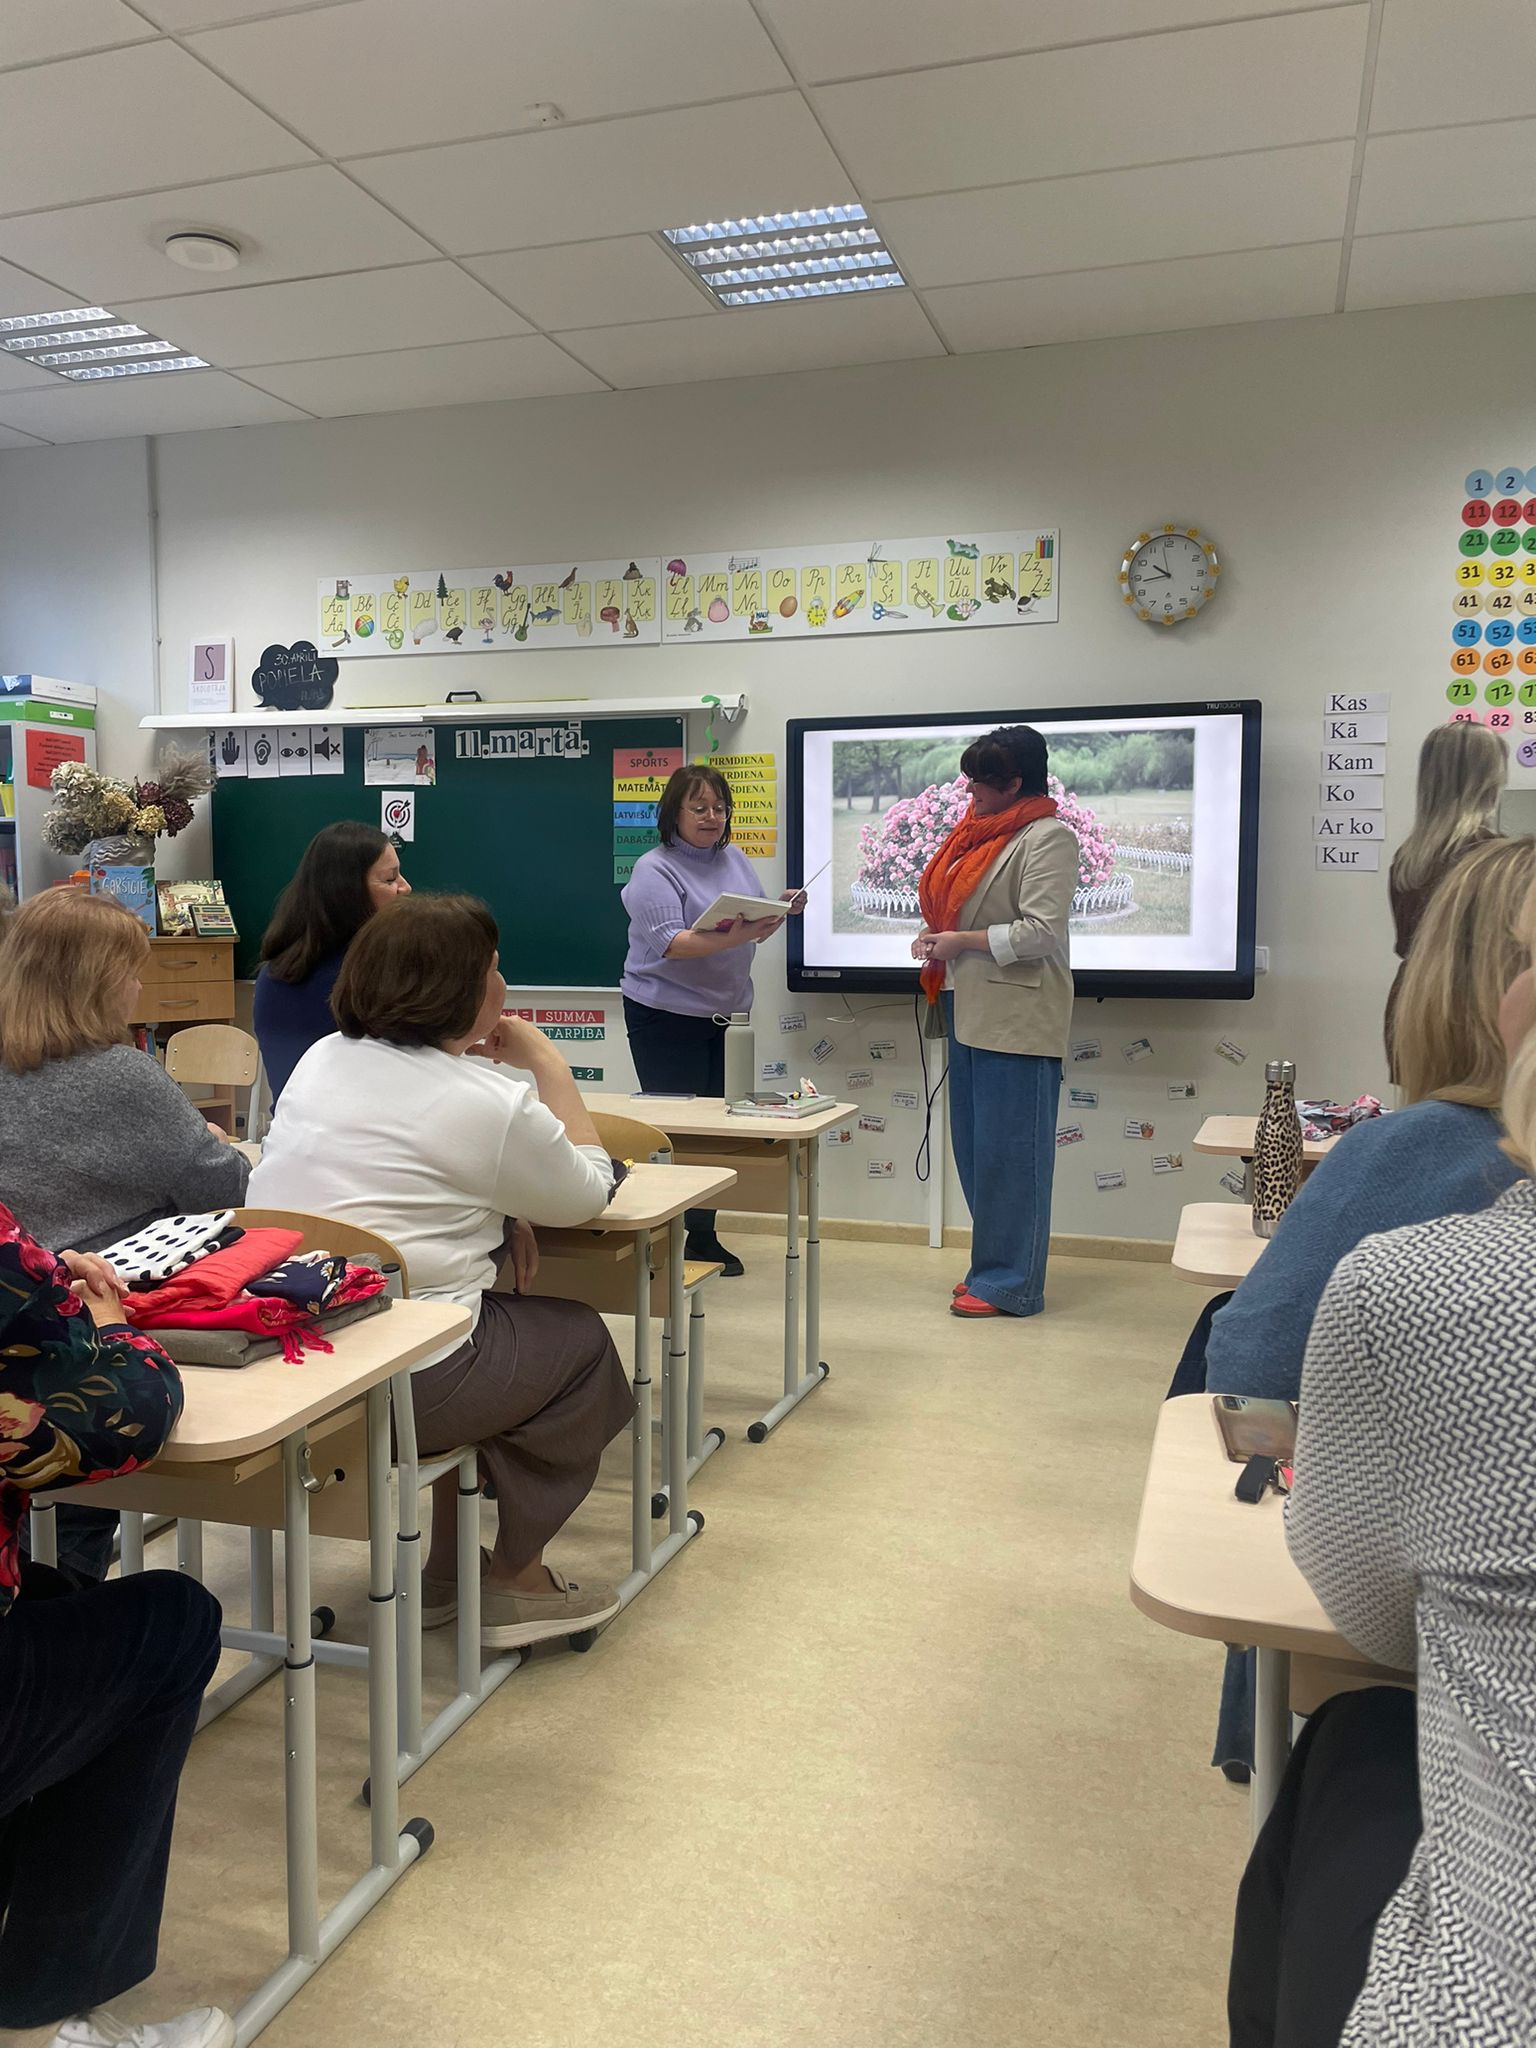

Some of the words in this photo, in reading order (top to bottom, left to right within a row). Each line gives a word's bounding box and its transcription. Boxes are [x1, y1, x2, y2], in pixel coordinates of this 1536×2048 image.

[1474, 478, 1484, 491] 1
[1505, 476, 1516, 489] 2
[1468, 505, 1486, 519] 11
[1499, 505, 1518, 518] 12
[1527, 504, 1536, 517] 1
[1164, 540, 1175, 548] 12
[1465, 533, 1484, 547] 21
[1496, 531, 1516, 545] 22
[1527, 537, 1536, 551] 2
[1461, 565, 1480, 579] 31
[1495, 566, 1514, 580] 32
[1526, 563, 1536, 576] 3
[1459, 595, 1479, 608] 41
[1492, 596, 1512, 609] 42
[1524, 592, 1536, 605] 4
[1458, 624, 1476, 638] 51
[1492, 625, 1512, 640] 52
[204, 646, 215, 680] S
[1456, 653, 1476, 666] 61
[1491, 653, 1512, 669] 62
[1452, 683, 1471, 697] 71
[1491, 684, 1512, 700] 72
[1525, 683, 1536, 697] 7
[1330, 694, 1368, 711] Kas
[1491, 714, 1510, 727] 82
[1330, 722, 1358, 739] Kā
[630, 758, 669, 768] SPORTS
[709, 756, 765, 766] PIRMDIENA
[1328, 753, 1374, 771] Kam
[721, 770, 764, 780] TRDIENA
[617, 782, 667, 792] MATEMĀT
[730, 784, 766, 794] ŠDIENA
[1327, 785, 1355, 802] Ko
[732, 800, 773, 809] RTDIENA
[733, 816, 769, 825] TDIENA
[1318, 818, 1344, 835] Ar
[1350, 817, 1374, 835] ko
[1322, 847, 1360, 864] Kur
[545, 1011, 597, 1022] SUMMA
[586, 1069, 595, 1080] 2
